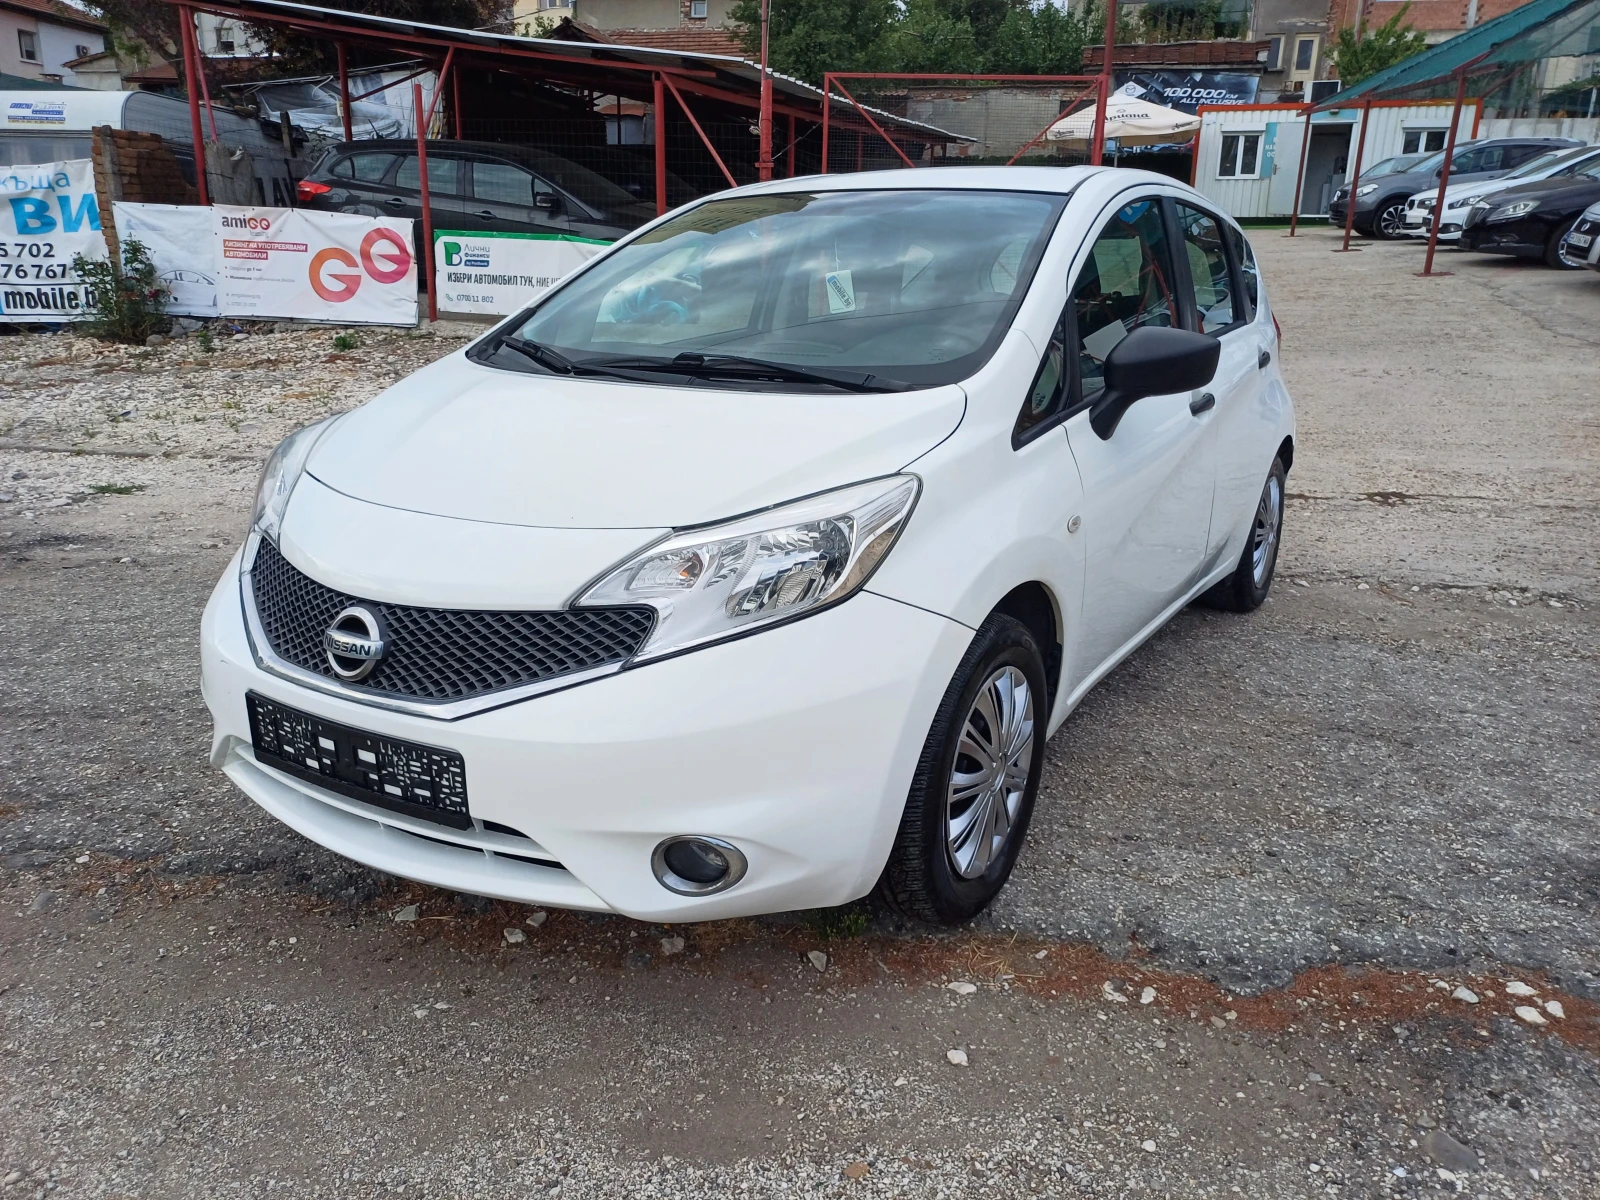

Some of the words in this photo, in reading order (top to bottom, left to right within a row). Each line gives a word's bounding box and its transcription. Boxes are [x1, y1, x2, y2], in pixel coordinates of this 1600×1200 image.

[1163, 87, 1191, 97] 100
[1192, 88, 1226, 99] 000
[14, 242, 55, 258] 702
[224, 240, 249, 248] ЛИЗИНГ
[249, 241, 258, 249] НА
[258, 242, 306, 251] УПОТРЕБЯВАНИ
[463, 243, 490, 253] Лични
[225, 251, 267, 259] АВТОМОБИЛИ
[30, 263, 67, 279] 767
[447, 271, 472, 284] ИЗБЕРИ
[473, 273, 518, 286] АВТОМОБИЛ
[519, 275, 535, 288] ТУК,
[536, 276, 550, 288] НИЕ
[324, 633, 372, 657] NISSAN
